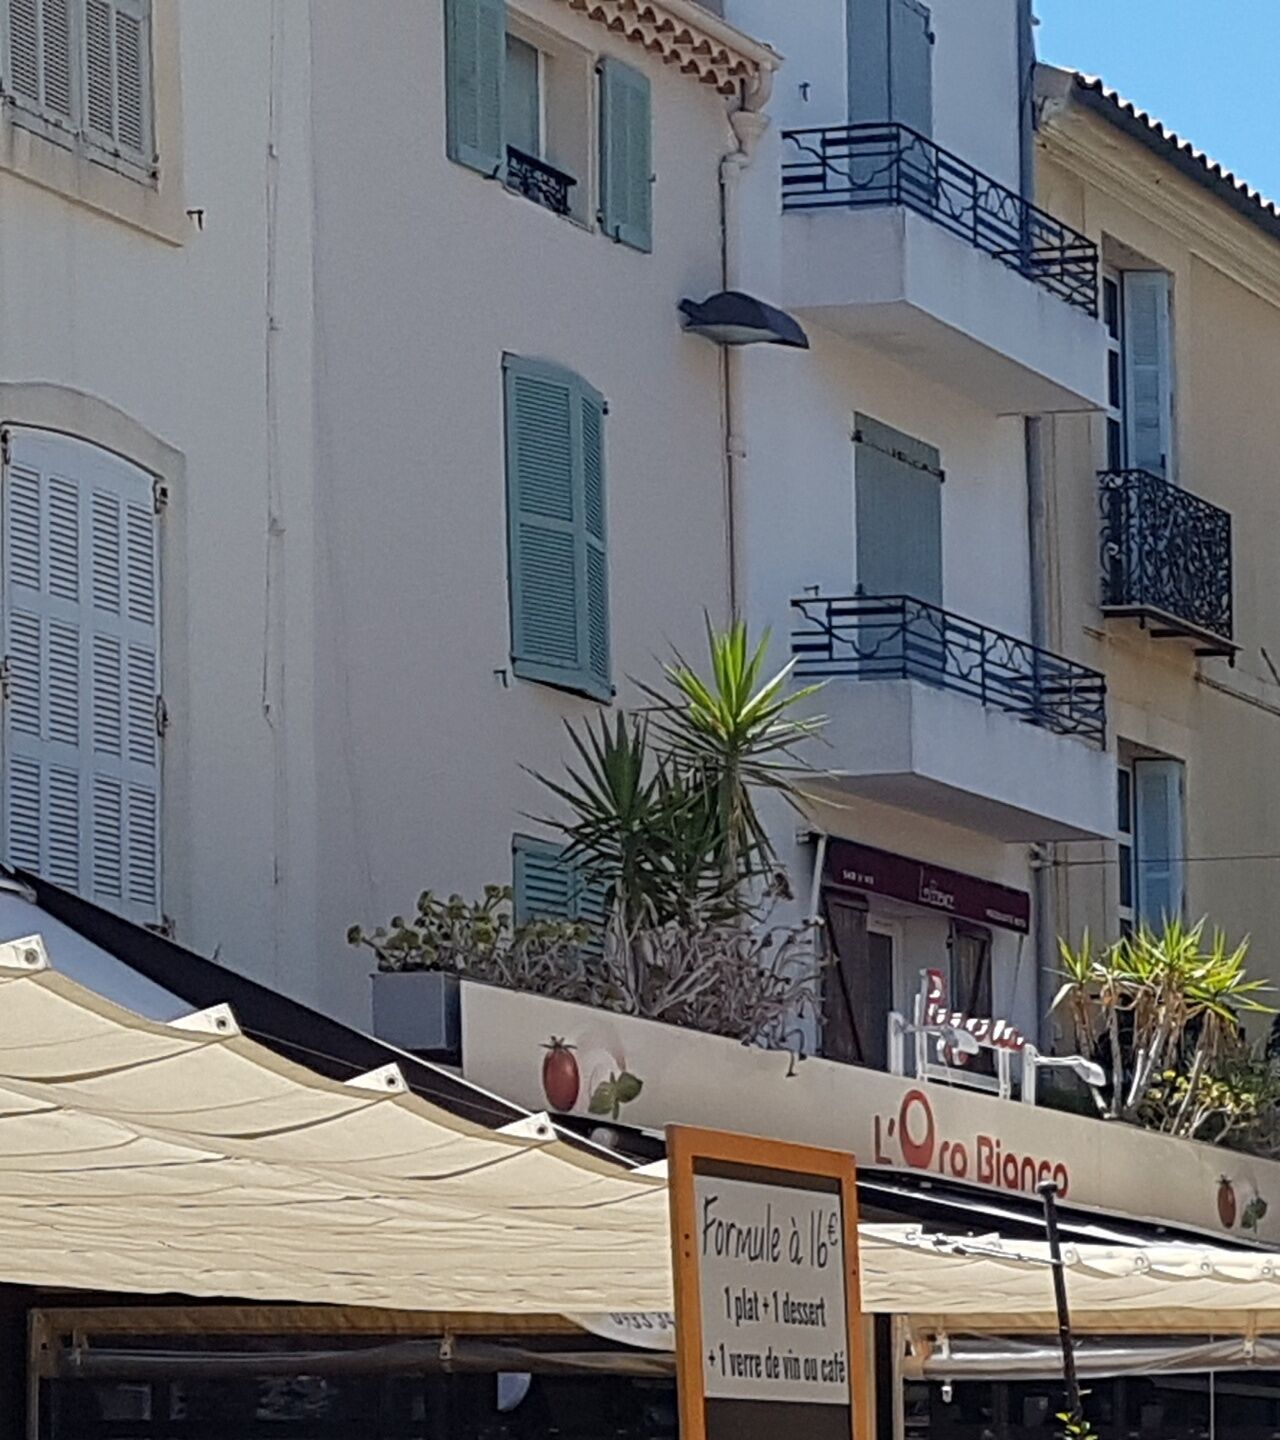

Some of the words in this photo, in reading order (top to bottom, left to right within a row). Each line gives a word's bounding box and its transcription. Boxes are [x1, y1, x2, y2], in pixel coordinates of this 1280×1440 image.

[874, 1089, 968, 1178] L'Oro
[976, 1134, 1069, 1199] Bianco
[703, 1196, 781, 1262] Formule
[789, 1216, 803, 1265] à
[724, 1286, 732, 1319] 1
[735, 1287, 760, 1328] plat
[772, 1290, 779, 1323] 1
[782, 1292, 826, 1328] dessert
[719, 1343, 726, 1377] 1
[729, 1352, 762, 1378] verre
[765, 1346, 780, 1379] de
[782, 1348, 801, 1380] vin
[803, 1357, 818, 1381] ou
[821, 1350, 845, 1383] café
